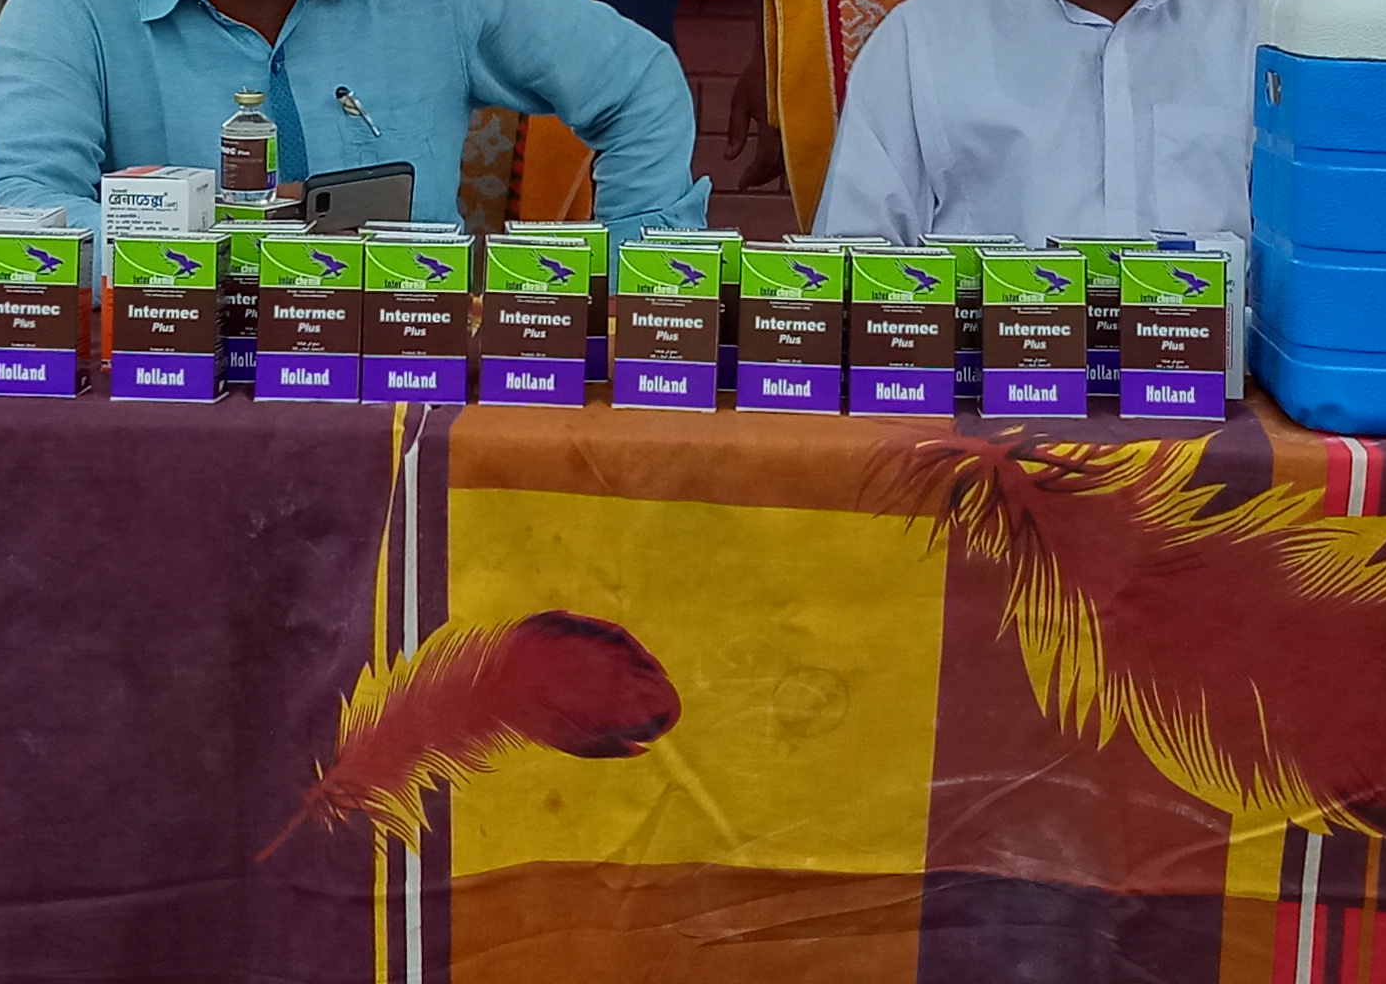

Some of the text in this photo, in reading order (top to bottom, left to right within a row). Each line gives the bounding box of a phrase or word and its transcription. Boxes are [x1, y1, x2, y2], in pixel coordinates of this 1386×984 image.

[128, 304, 199, 320] Intermec
[273, 304, 346, 320] Intermec
[379, 308, 451, 325] Intermec
[499, 309, 572, 326] Intermec
[12, 317, 36, 329] Plus
[151, 322, 175, 333] Plus
[297, 322, 321, 333] Plus
[632, 312, 704, 329] Intermec
[755, 315, 826, 332] Intermec
[867, 319, 939, 335] Intermec
[403, 325, 427, 337] Plus
[523, 327, 546, 339] Plus
[655, 330, 679, 341] Plus
[999, 322, 1071, 336] Intermec
[1136, 322, 1210, 338] Intermec
[778, 333, 802, 345] Plus
[891, 337, 914, 348] Plus
[1023, 339, 1047, 350] Plus
[1161, 340, 1185, 351] Plus
[136, 367, 185, 386] Holland
[280, 367, 330, 386] Holland
[388, 371, 437, 389] Holland
[505, 372, 555, 391] Holland
[638, 374, 688, 394] Holland
[762, 377, 812, 397] Holland
[875, 382, 925, 401] Holland
[1008, 384, 1058, 402] Holland
[1146, 385, 1196, 404] Holland
